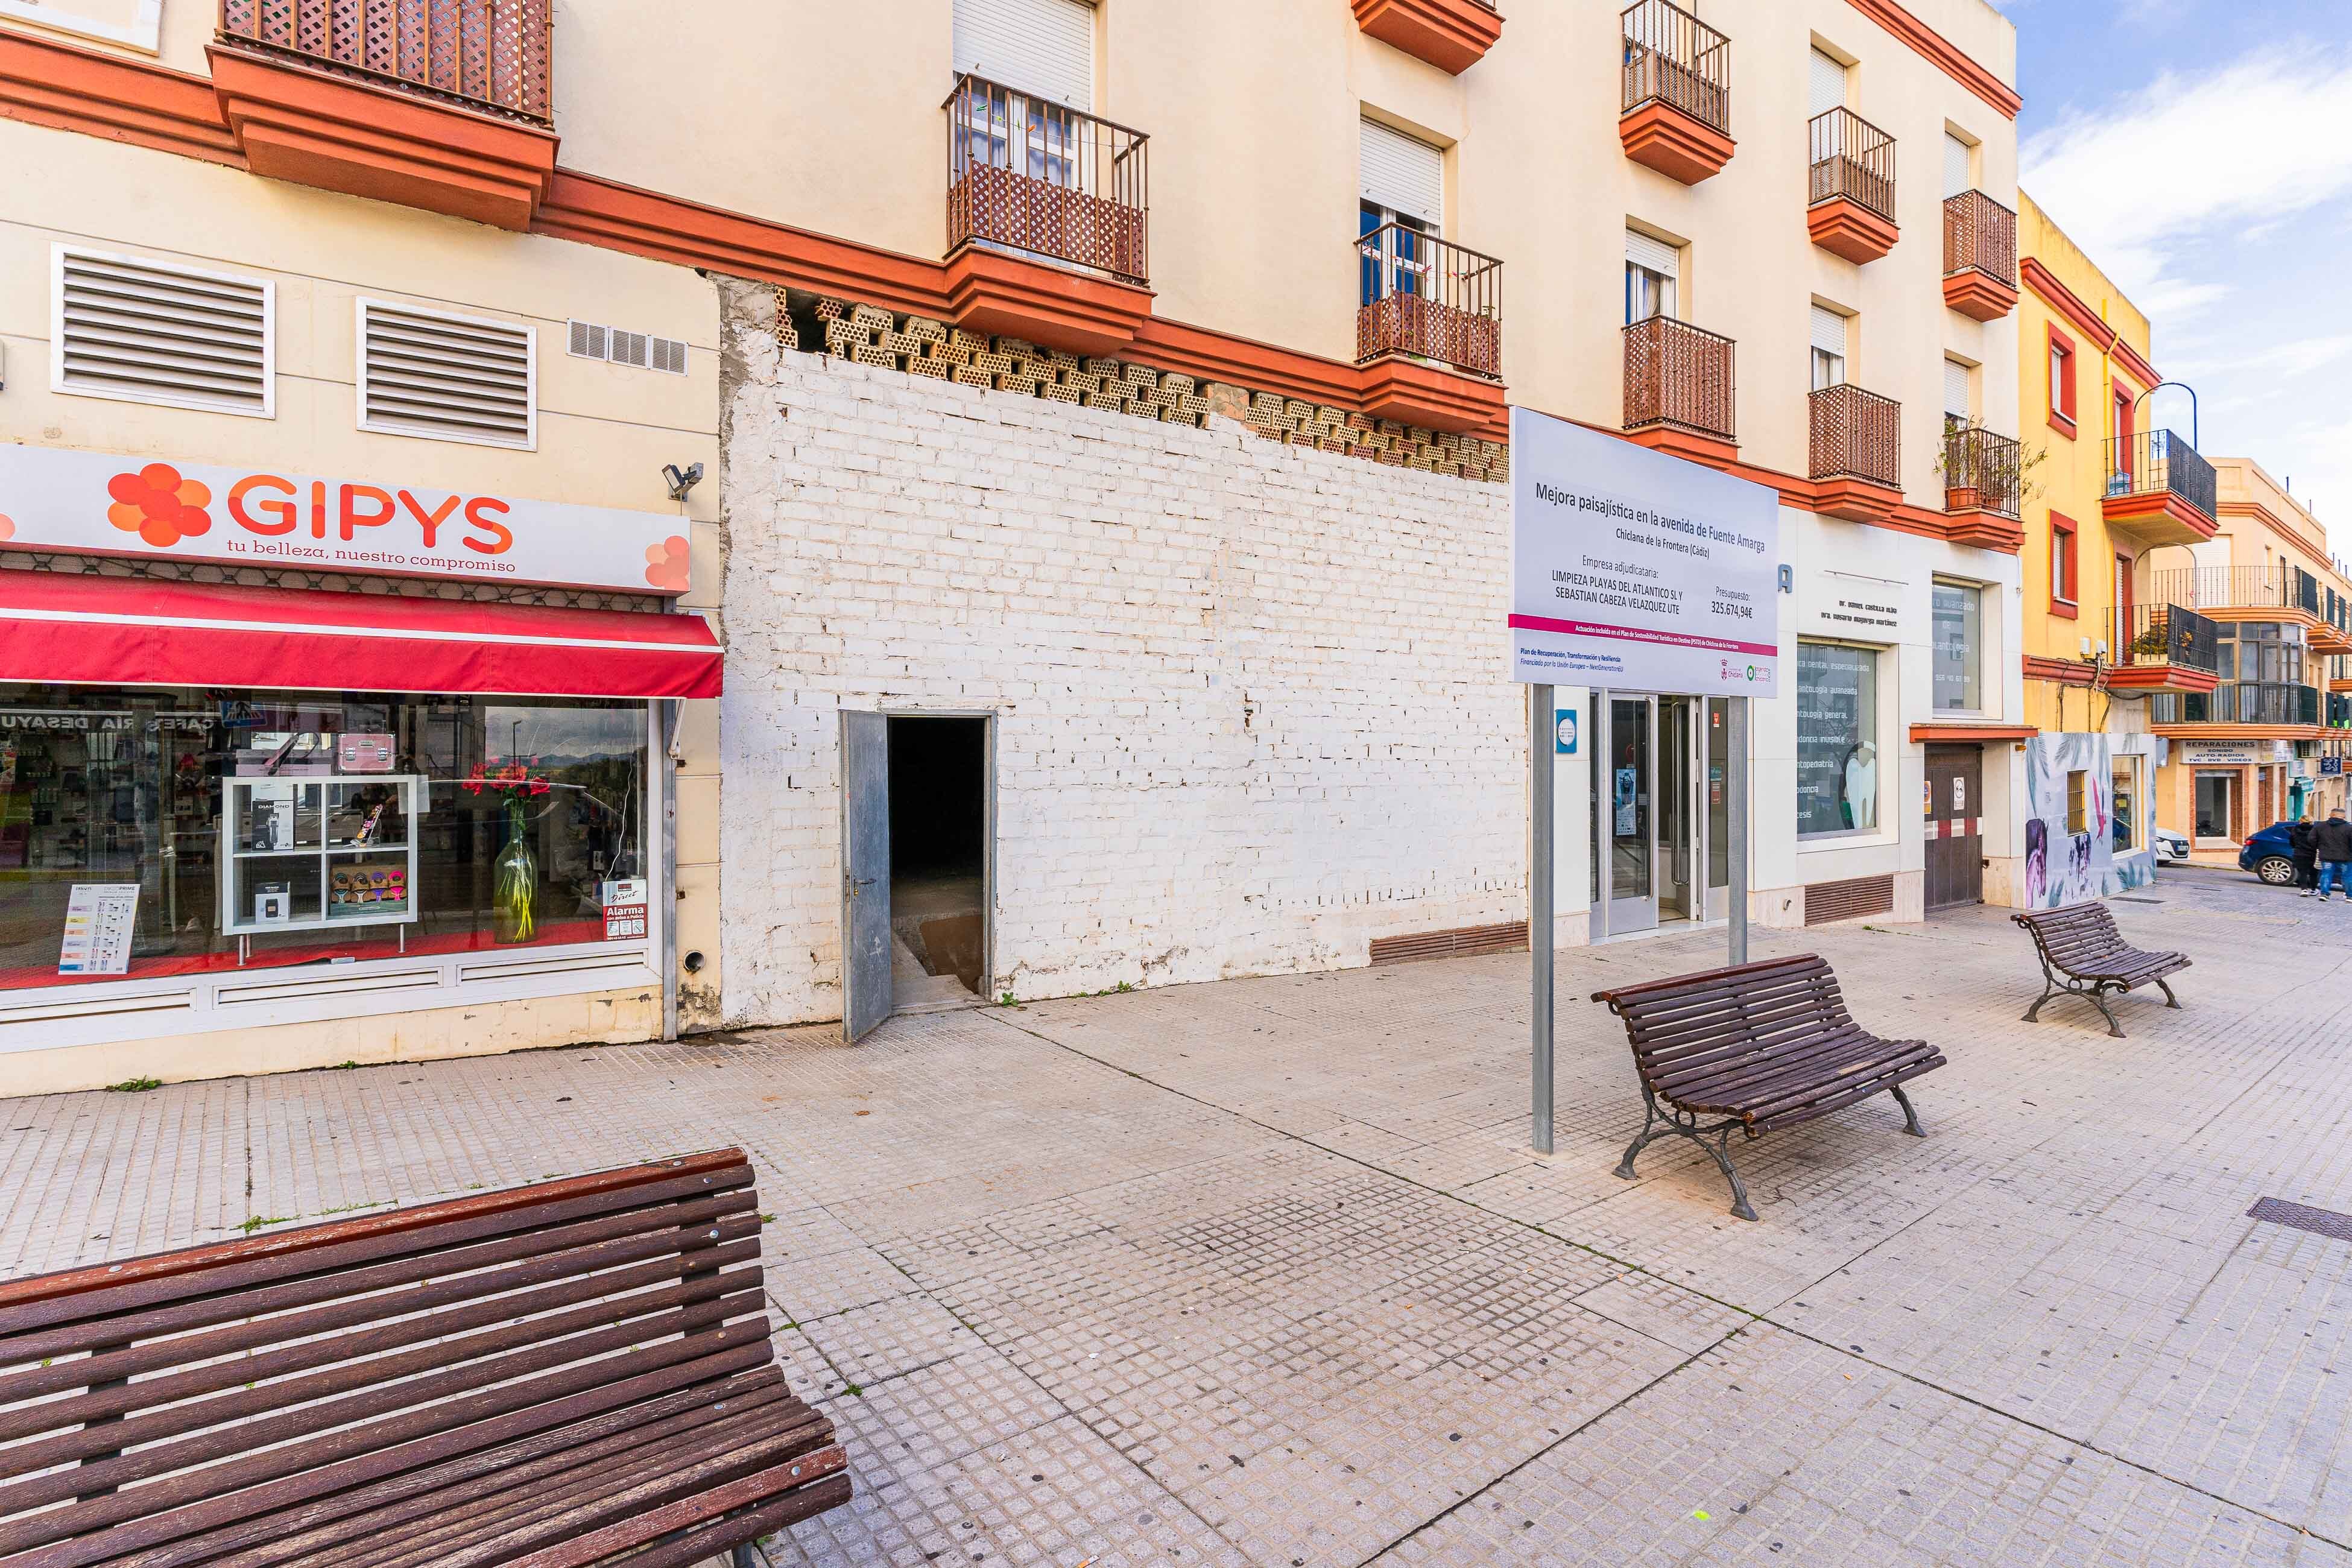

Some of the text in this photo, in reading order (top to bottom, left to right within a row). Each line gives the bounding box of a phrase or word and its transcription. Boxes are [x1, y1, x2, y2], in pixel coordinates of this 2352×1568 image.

[228, 475, 513, 555] GIPYS
[1536, 482, 1765, 554] Mejora paisajística en la avenida de Fuente Amarga
[1616, 528, 1709, 560] Chiclana de la Frontera (Cádiz)
[227, 540, 516, 572] tu belleza, nuestro compromiso
[1582, 555, 1659, 579] Empresa adjudicataria:
[1552, 569, 1683, 601] LIMPIEZA PLAYAS DEL ATLANTICO SL Y
[1716, 586, 1750, 601] Presupuesto:
[1555, 586, 1680, 615] SEBASTIAN CABEZA VELAZQUEZ UTE
[1712, 601, 1753, 619] 325.674,94€
[1575, 625, 1595, 633] Actuación
[1635, 631, 1659, 640] Sostenibilidad
[1520, 647, 1530, 656] Plan
[1537, 649, 1566, 659] Recuperación,
[1567, 652, 1598, 661] Transformación
[1520, 658, 1543, 666] Financiado
[1569, 662, 1585, 670] Europea
[1589, 664, 1623, 672] NextGenerationEU
[1824, 711, 1848, 719] general
[611, 890, 638, 903] Direct
[607, 906, 644, 916] Alarma
